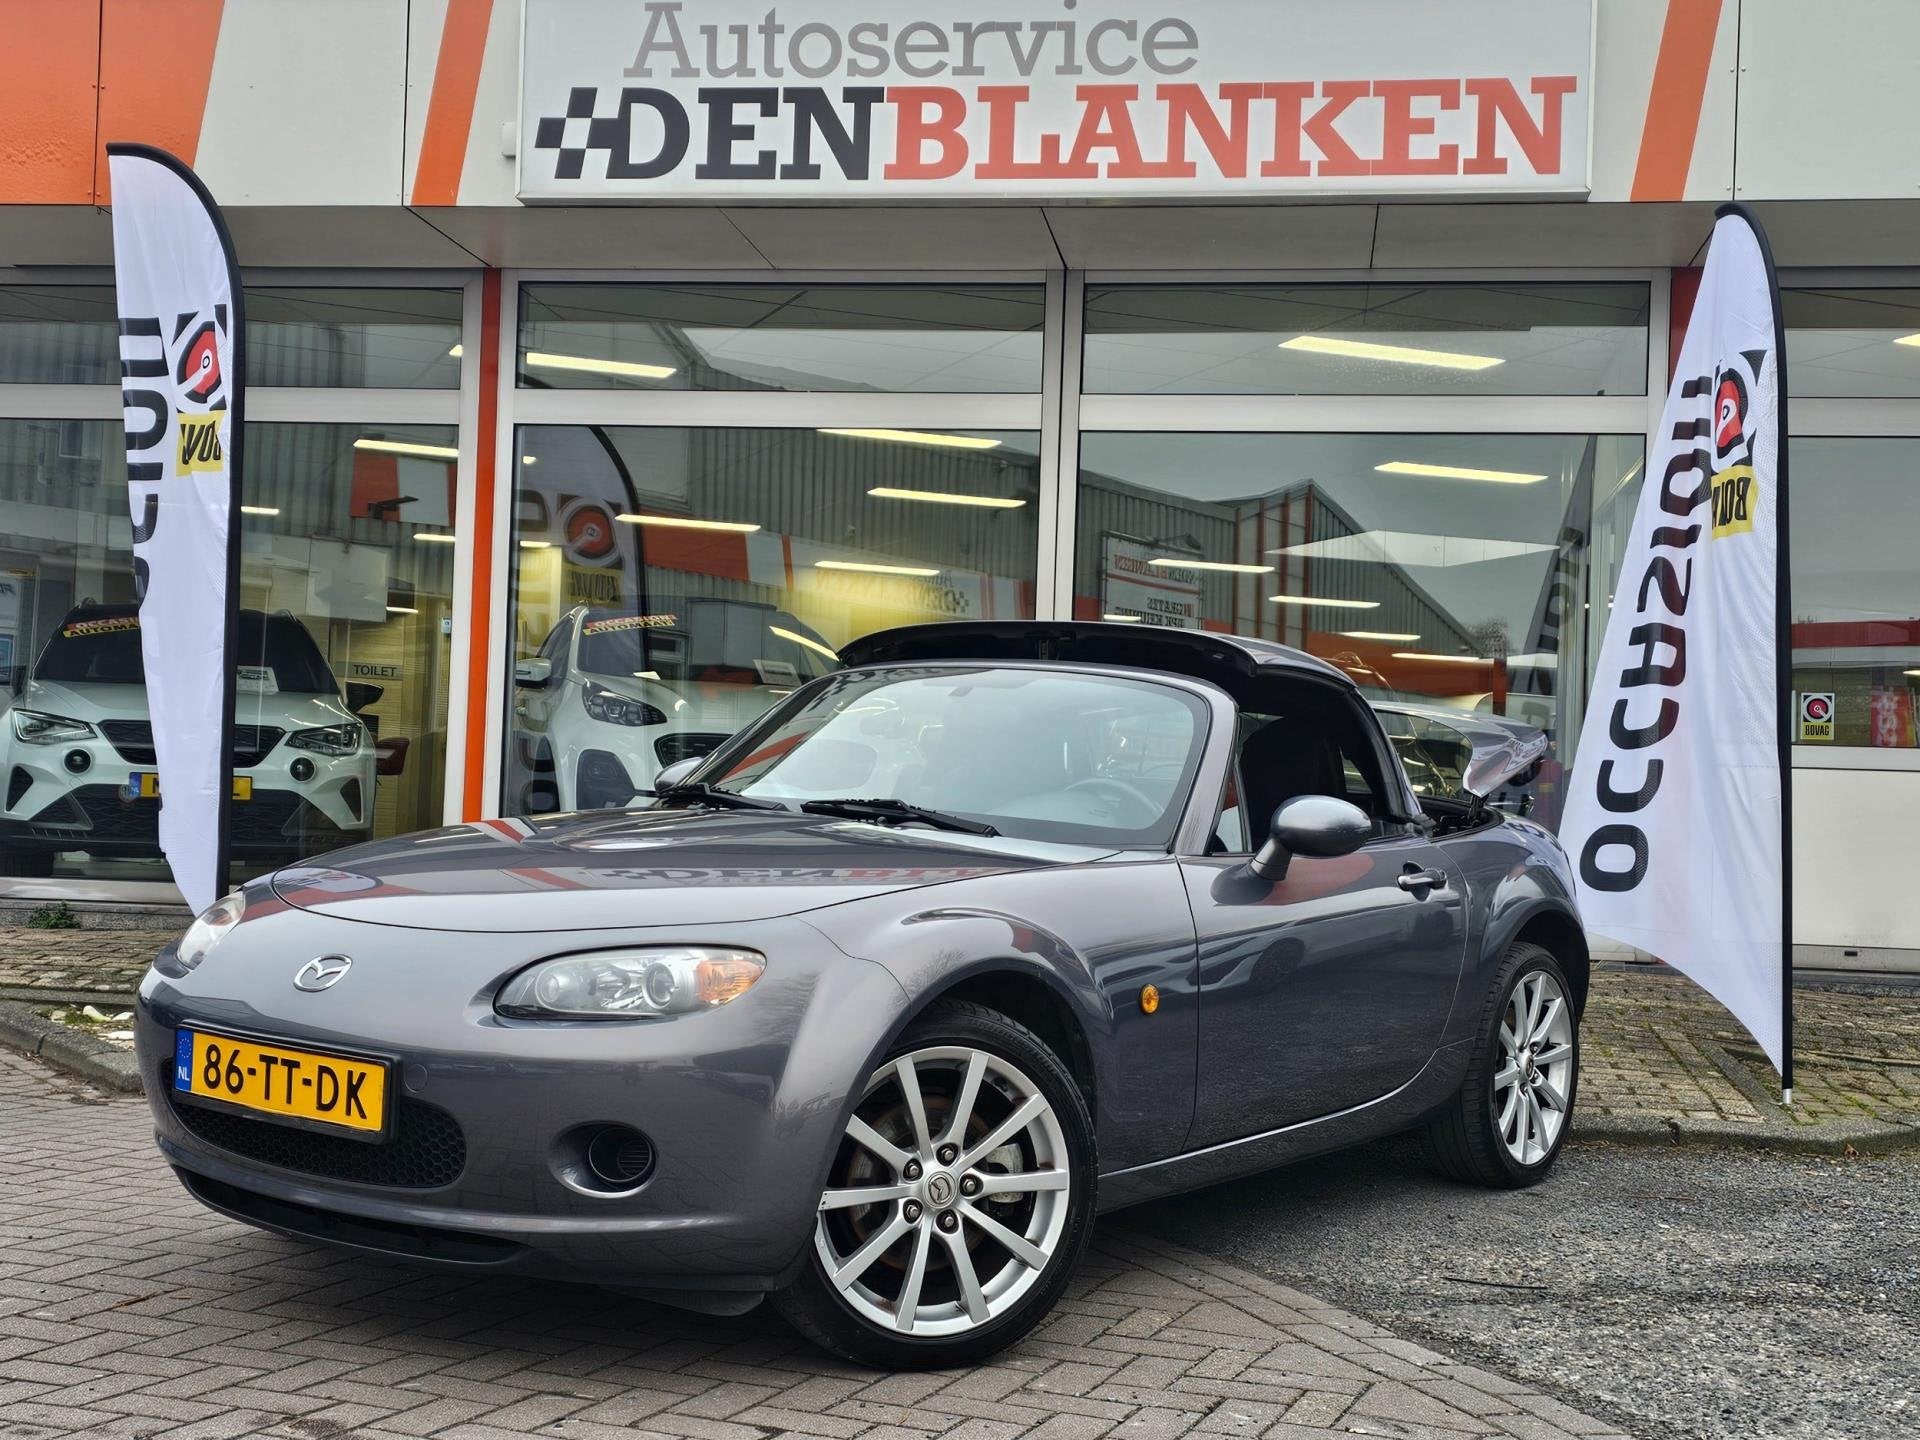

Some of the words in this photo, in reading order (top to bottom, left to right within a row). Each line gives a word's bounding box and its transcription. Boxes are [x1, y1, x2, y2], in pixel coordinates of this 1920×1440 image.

[622, 0, 1200, 79] Autoservice
[605, 76, 1577, 181] DENBLANKEN
[353, 664, 397, 677] TOILET
[1805, 724, 1830, 736] BOVAG
[178, 1066, 190, 1081] NL
[203, 1043, 368, 1120] 86-TT-DK
